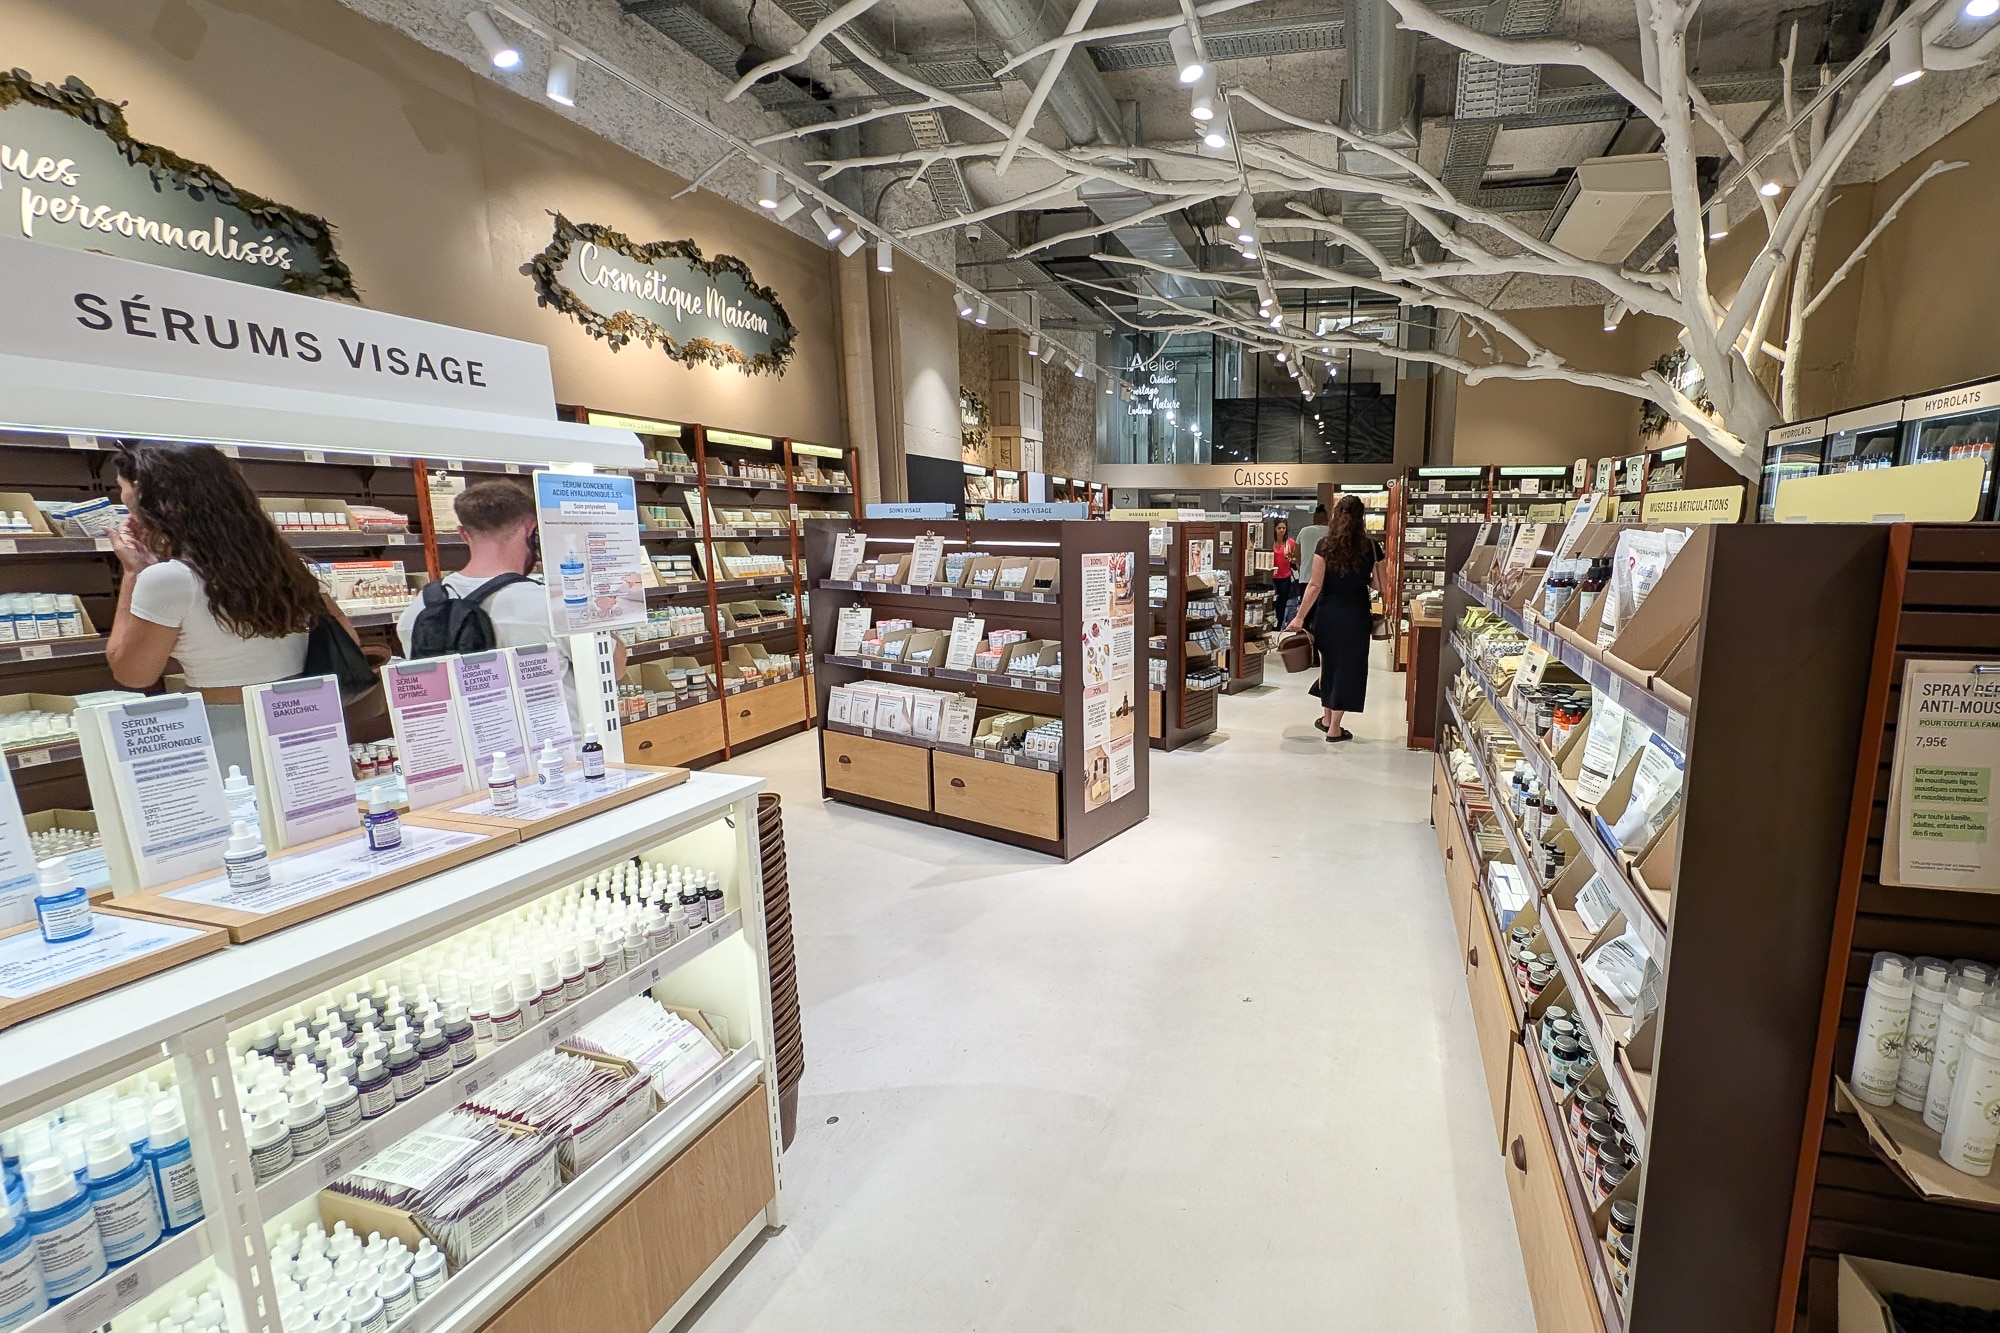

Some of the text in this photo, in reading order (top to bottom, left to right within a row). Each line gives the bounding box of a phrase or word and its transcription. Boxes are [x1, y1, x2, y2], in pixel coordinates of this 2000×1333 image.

[21, 186, 293, 271] personnalisés
[578, 242, 769, 336] Cosmétique Maison
[74, 292, 488, 388] SÉRUMS VISAGE
[1152, 397, 1180, 410] Nature
[1925, 391, 1981, 412] HYDROLATS
[1780, 426, 1812, 440] HYDROLATS
[552, 489, 570, 497] ACIDE
[1649, 498, 1729, 513] MUSCLES & ARTICULATIONS
[469, 675, 492, 685] EXTRAIT
[1922, 683, 1972, 697] SPRAY
[273, 704, 320, 718] BAKUCHIOL
[123, 721, 185, 738] SPILANTHES
[1920, 719, 1942, 727] POUR
[127, 733, 167, 747] & ACIDE
[128, 735, 203, 756] HYALURONIQUE
[1916, 736, 1948, 749] 7,95€
[1915, 768, 1944, 776] Efficacité
[1924, 777, 1958, 786] moustiques
[1915, 785, 1948, 794] moustiques
[1921, 794, 1954, 802] moustiques
